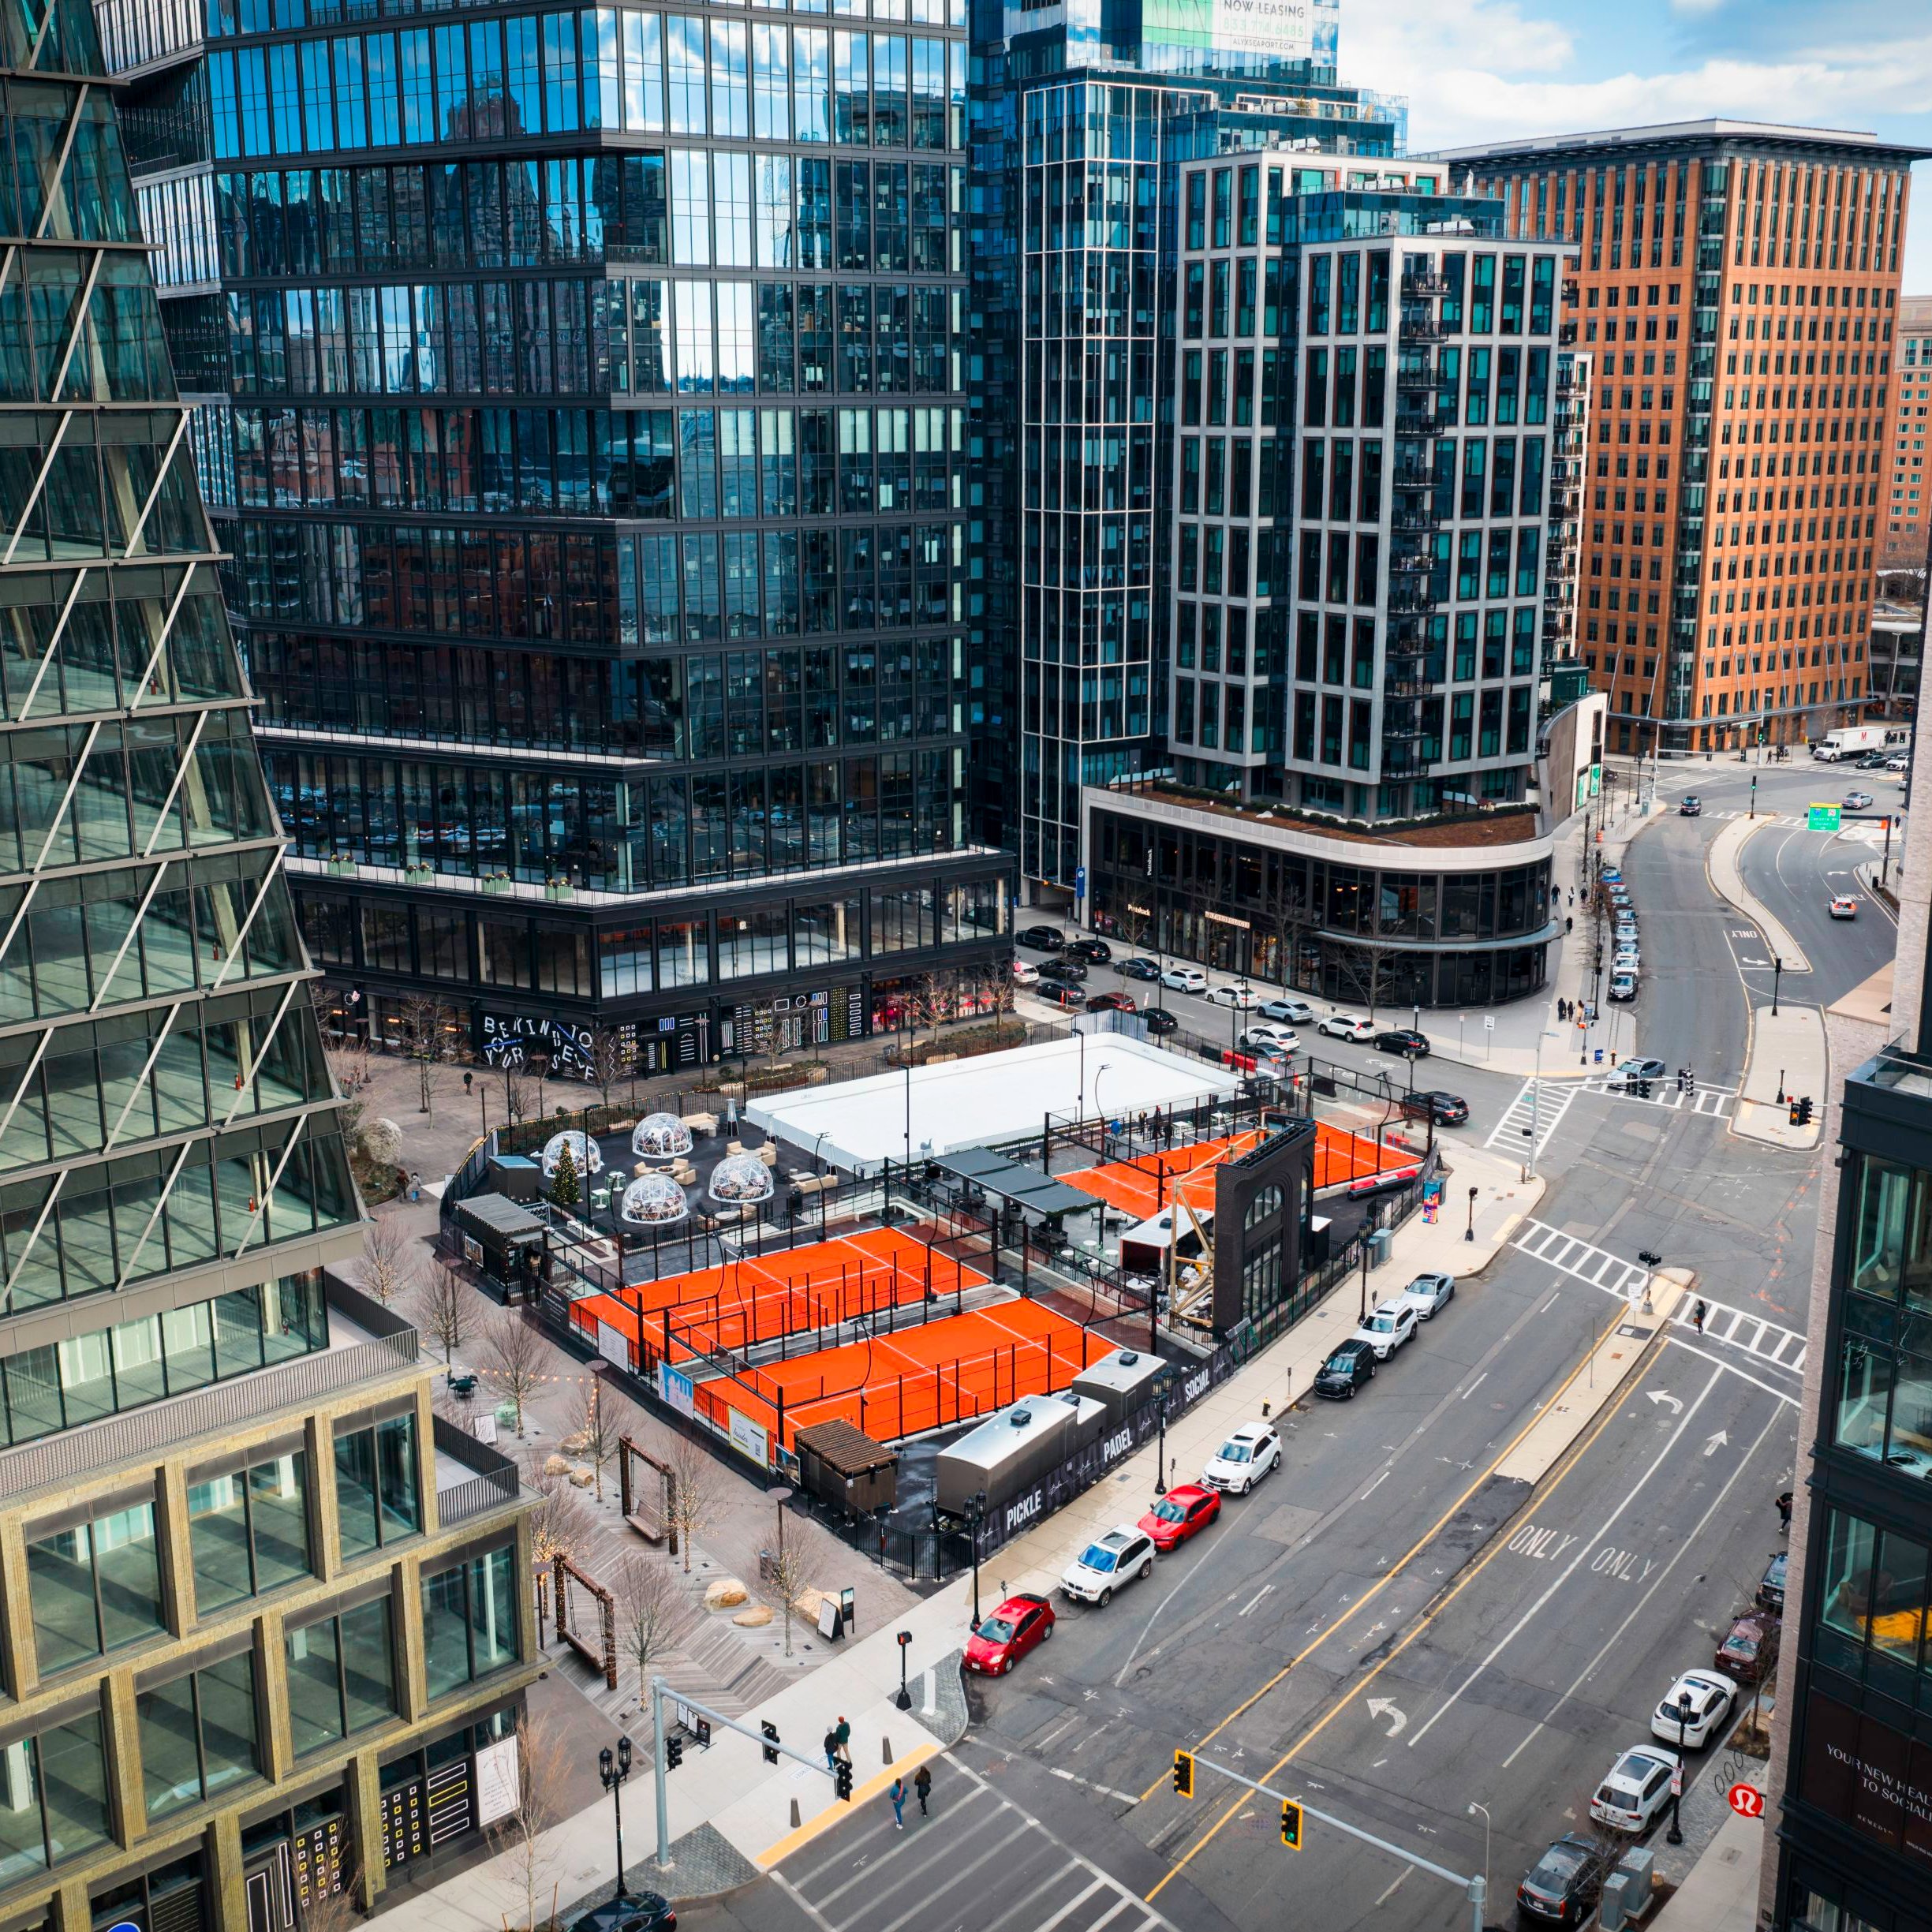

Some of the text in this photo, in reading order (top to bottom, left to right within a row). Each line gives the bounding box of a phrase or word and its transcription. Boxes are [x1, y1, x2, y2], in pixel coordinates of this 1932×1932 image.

[1224, 0, 1305, 18] NOW LEASING
[1232, 37, 1295, 50] ALYXSEAPORT.COM
[1732, 930, 1758, 939] ONLY
[1184, 1368, 1210, 1403] SOCIAL
[1104, 1427, 1133, 1463] PADEL
[1007, 1489, 1042, 1531] PICKLE
[1508, 1525, 1579, 1560] ONLY
[1590, 1547, 1659, 1584] ONLY
[1827, 1743, 1861, 1769] YOUR
[1864, 1763, 1893, 1785] NEW
[1862, 1776, 1878, 1792] TO
